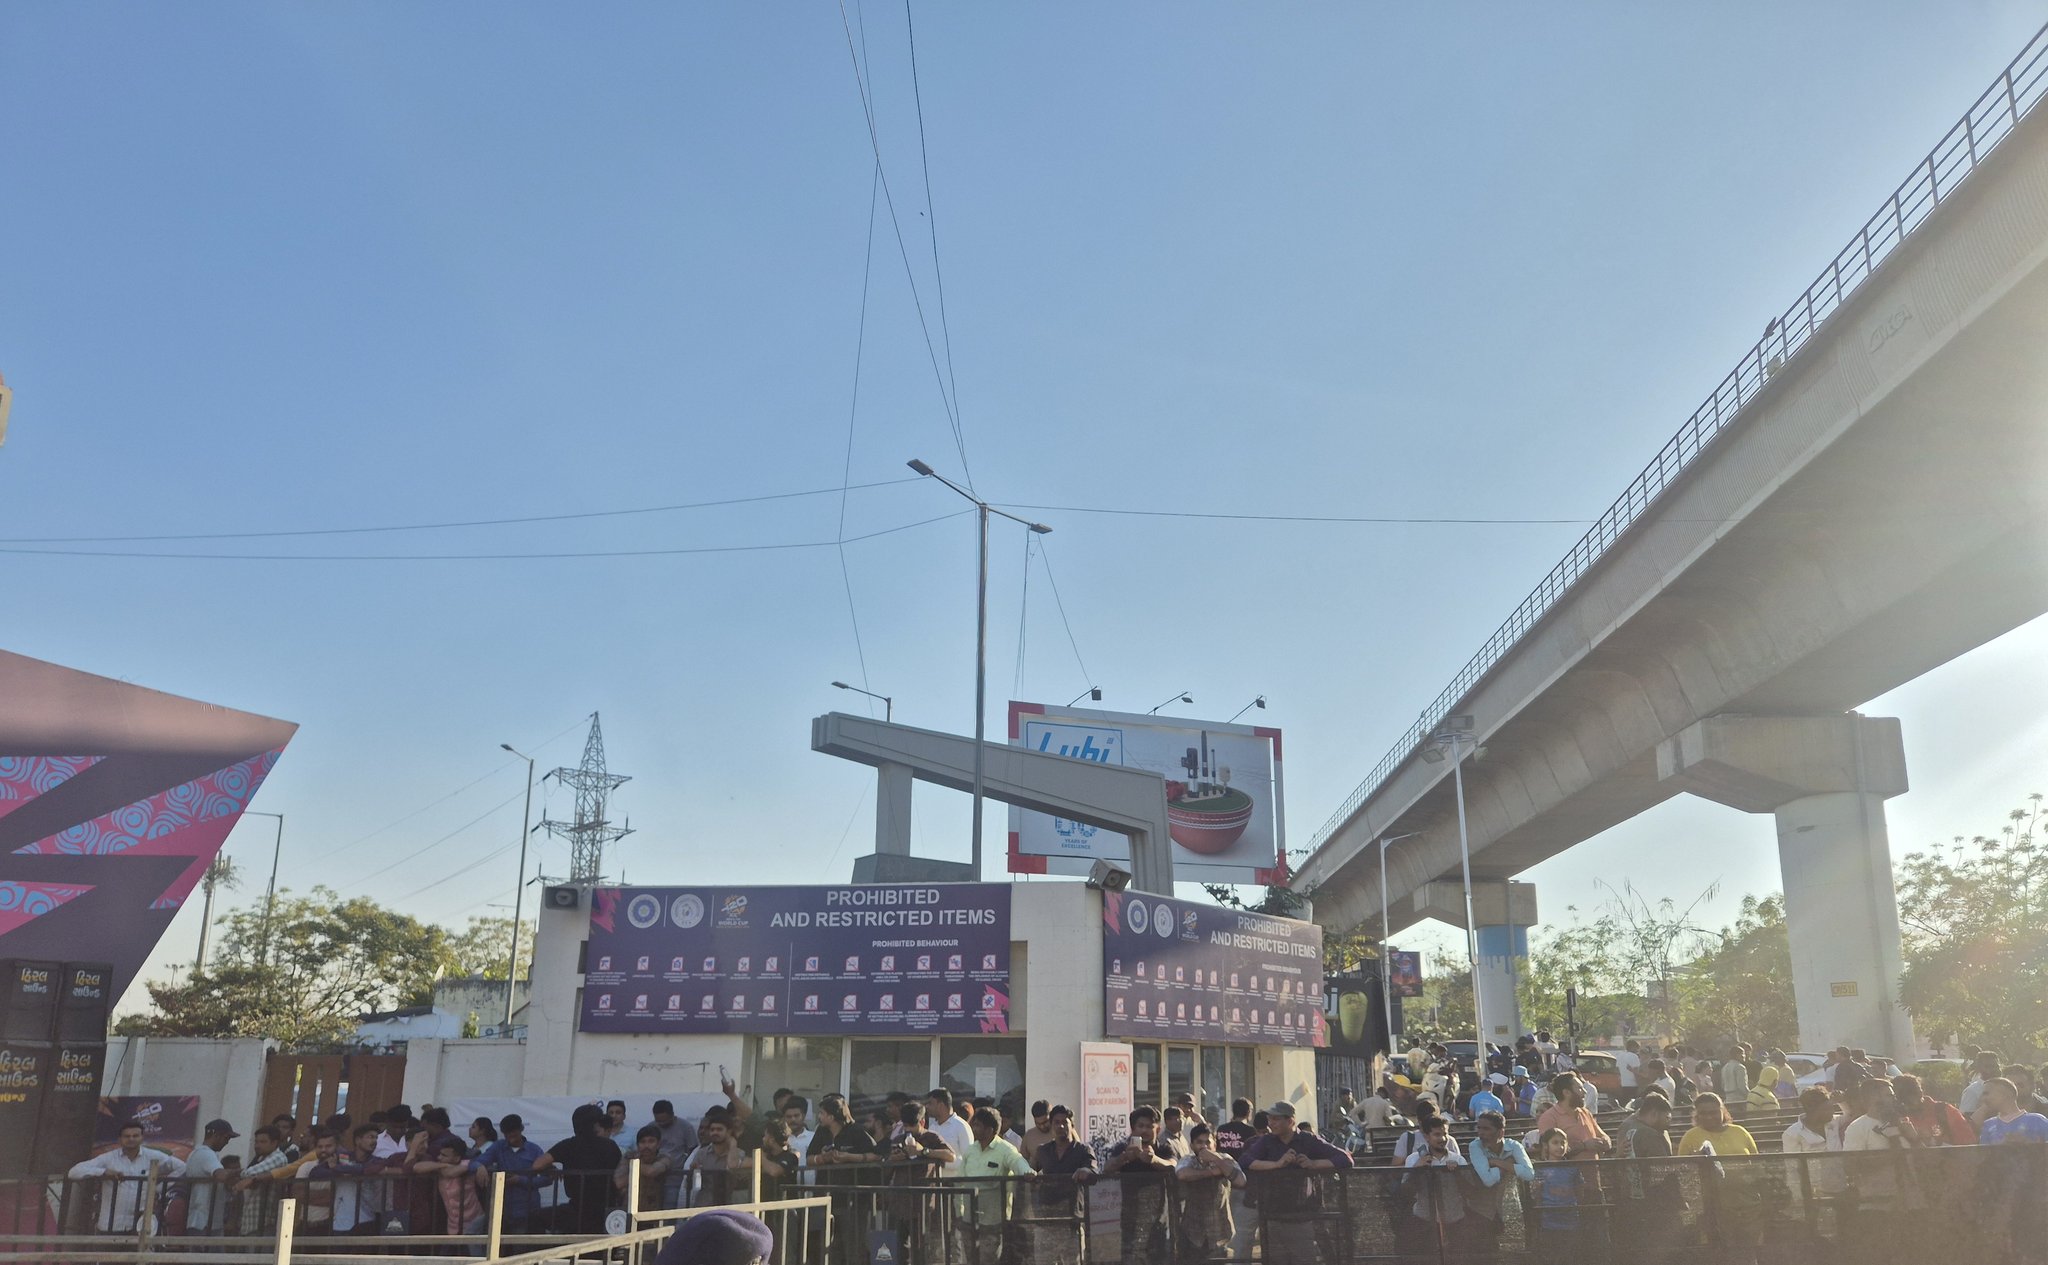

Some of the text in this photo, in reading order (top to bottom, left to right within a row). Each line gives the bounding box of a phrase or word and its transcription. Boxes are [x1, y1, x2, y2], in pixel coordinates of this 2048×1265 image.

[827, 888, 940, 906] PROHIBITED
[770, 908, 996, 928] AND RESTRICTED ITEMS
[1237, 916, 1292, 937] PROHIBITED
[872, 939, 959, 948] PROHIBITED BEHAVIOUR
[1210, 933, 1317, 959] AND RESTRICTED ITEMS
[75, 970, 101, 985] હિરલ
[60, 1050, 91, 1068] હિરલ
[1096, 1086, 1119, 1095] SCAN TO
[1088, 1096, 1128, 1106] BOOK PARKING
